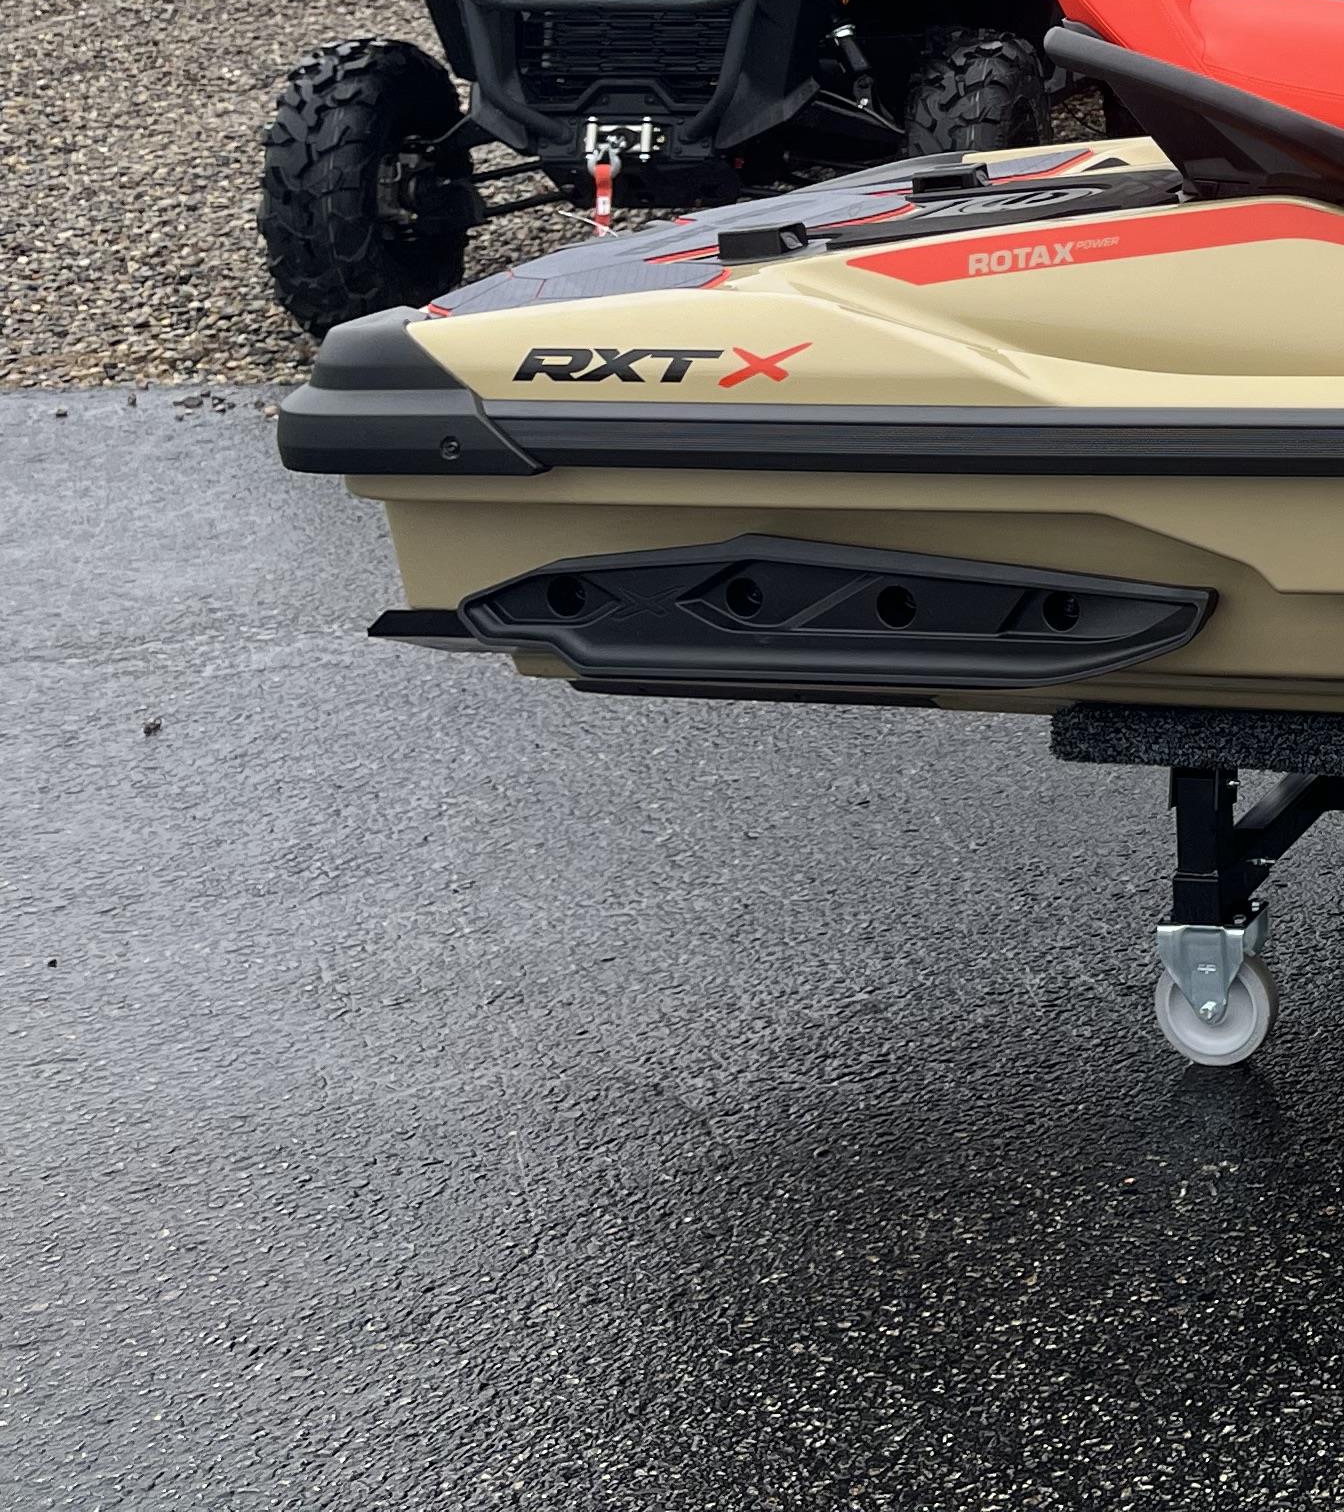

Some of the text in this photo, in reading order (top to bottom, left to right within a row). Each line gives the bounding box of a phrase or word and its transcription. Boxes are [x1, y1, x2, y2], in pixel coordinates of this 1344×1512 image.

[967, 236, 1120, 276] ROTAX POWER
[512, 341, 814, 389] RXT X
